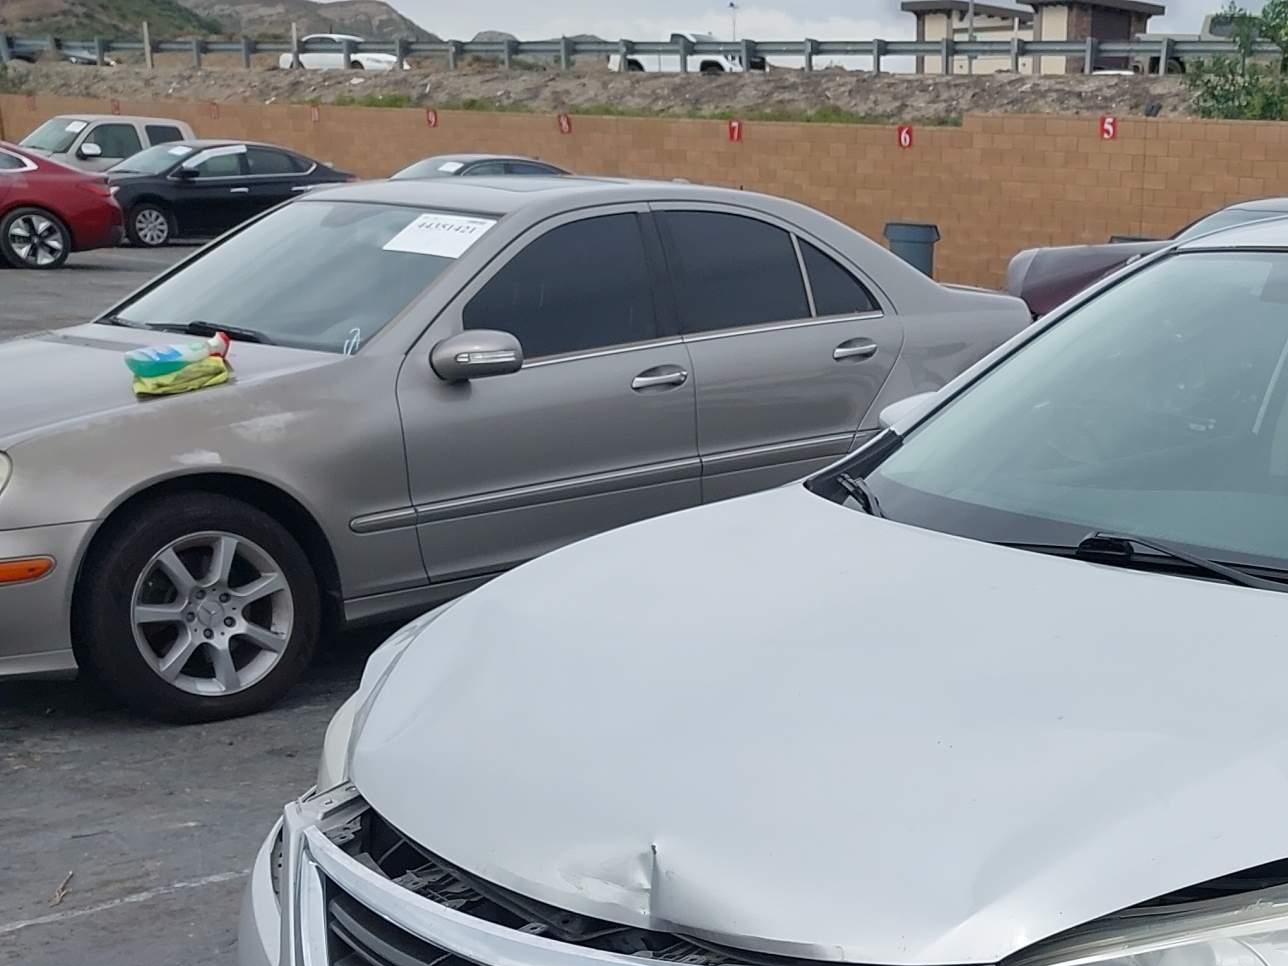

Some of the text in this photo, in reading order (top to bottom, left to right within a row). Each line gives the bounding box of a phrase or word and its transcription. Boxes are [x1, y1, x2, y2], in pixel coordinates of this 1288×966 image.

[731, 121, 740, 140] 7
[1103, 117, 1114, 138] 5
[901, 128, 910, 147] 6
